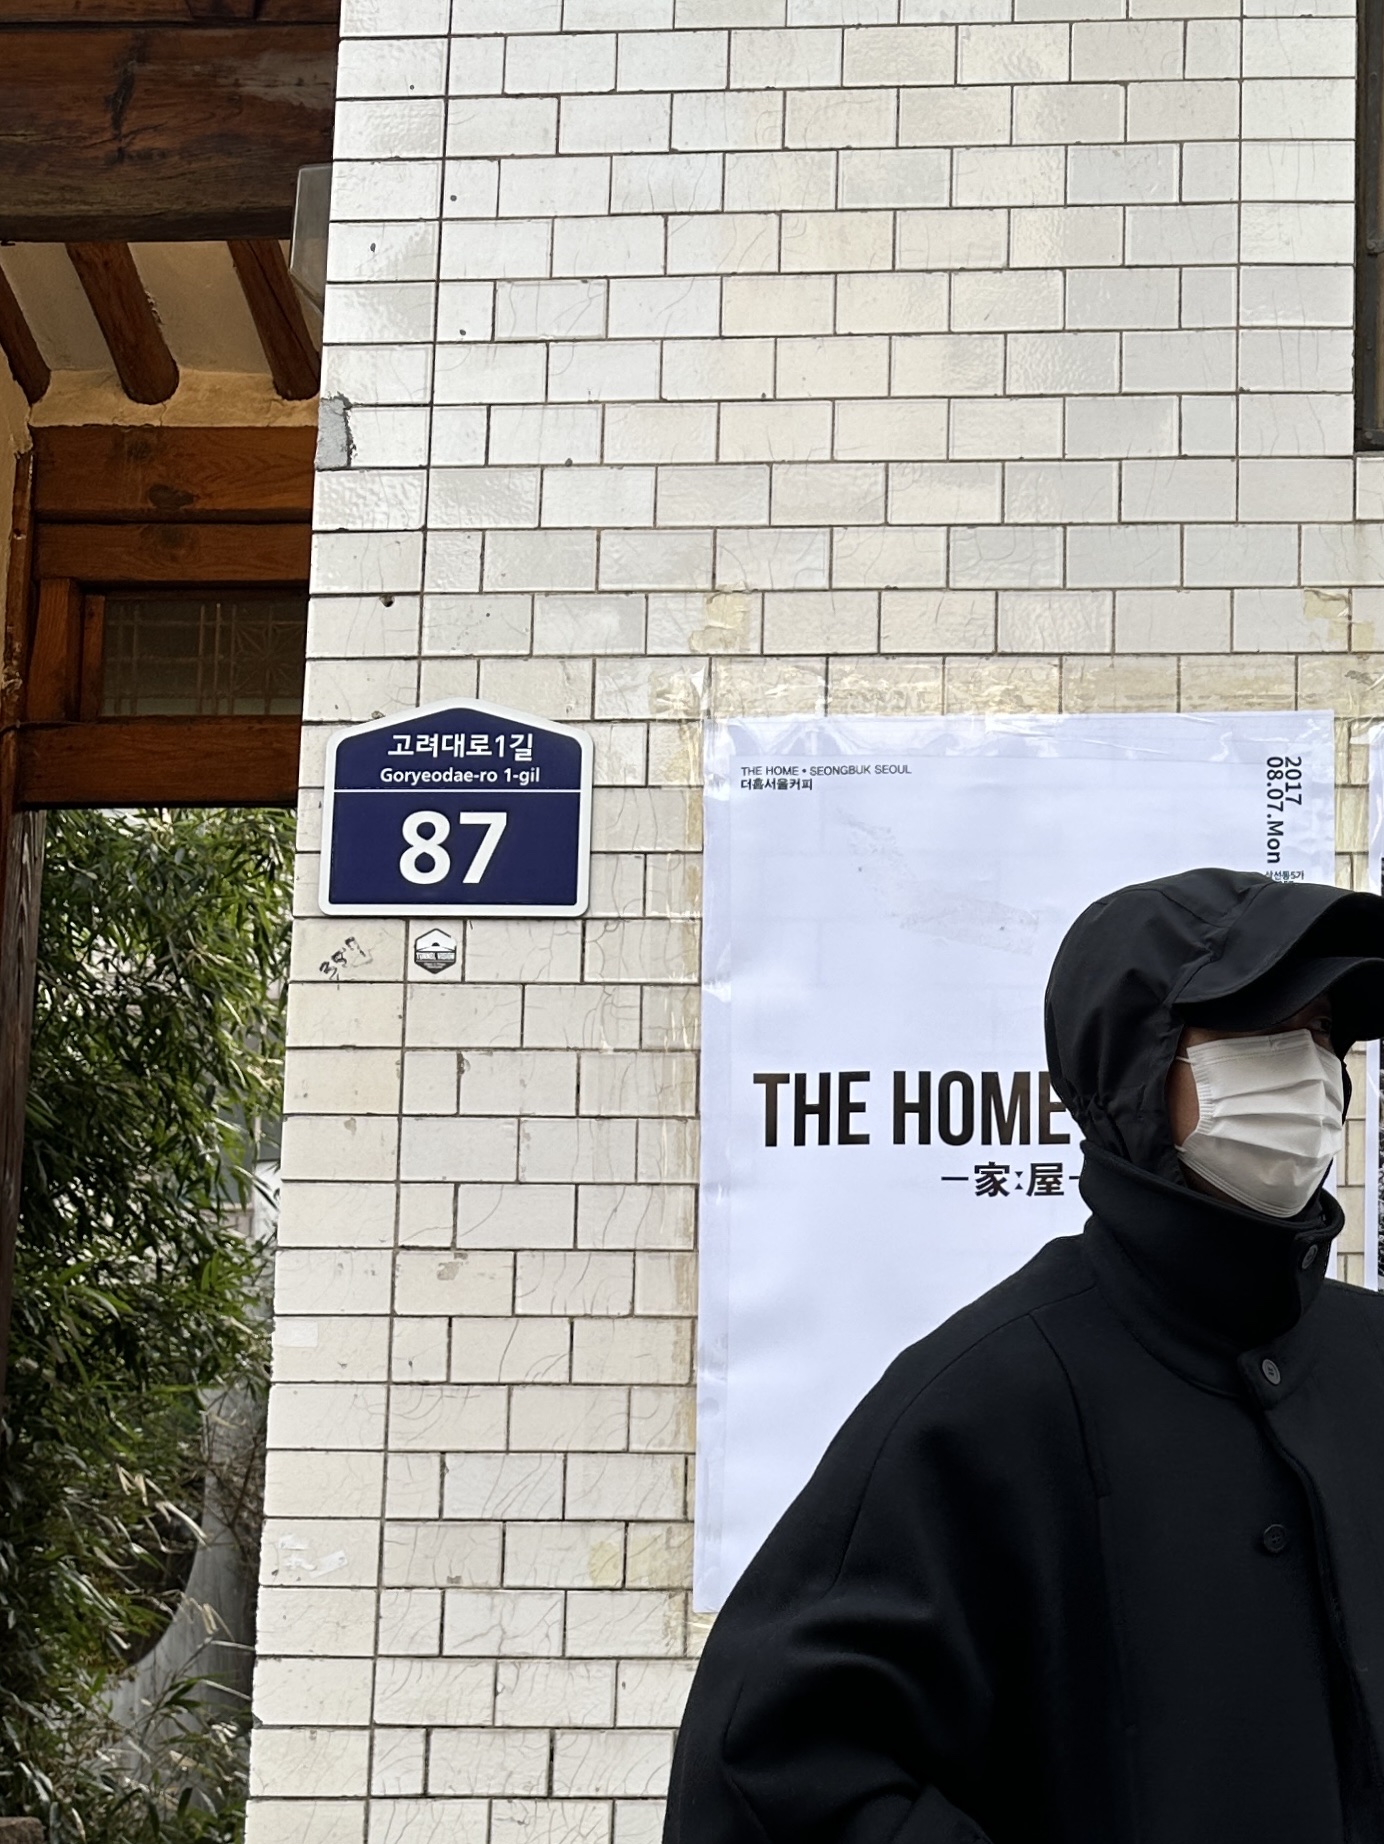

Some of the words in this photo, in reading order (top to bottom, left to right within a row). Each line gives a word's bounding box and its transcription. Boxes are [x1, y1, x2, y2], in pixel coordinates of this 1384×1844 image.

[387, 733, 533, 762] 고려대로1길
[741, 766, 763, 776] THE
[765, 766, 799, 776] HOME
[809, 765, 871, 776] SEONGBUK
[874, 764, 912, 774] SEOUL
[380, 767, 498, 785] Goryeodae-ro
[503, 767, 540, 785] 1-gil
[1285, 756, 1302, 806] 2017
[1266, 756, 1284, 864] 08.07.Mon
[399, 810, 508, 885] 87
[753, 1071, 870, 1147] THE
[893, 1070, 1071, 1146] HOME
